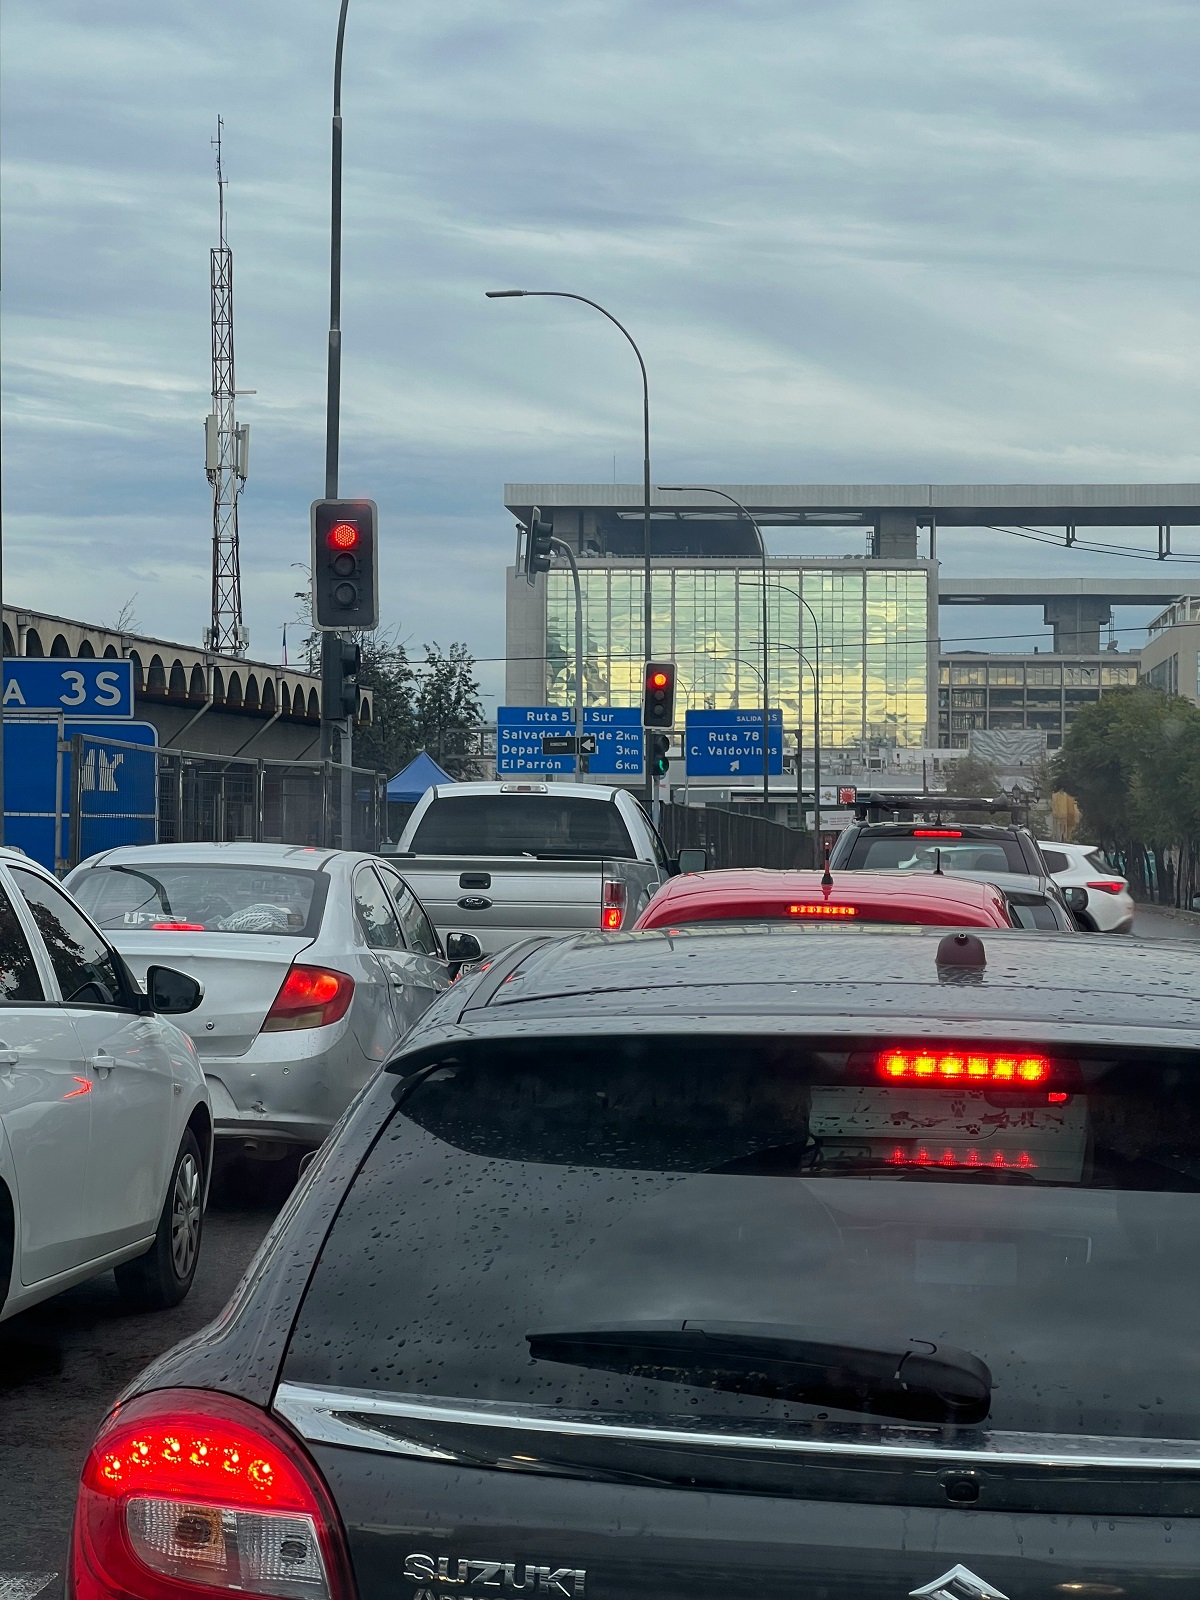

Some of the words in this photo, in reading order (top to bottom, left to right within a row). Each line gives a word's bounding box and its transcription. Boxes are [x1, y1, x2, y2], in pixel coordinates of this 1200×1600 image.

[59, 670, 121, 707] 3S
[527, 712, 557, 721] Ruta
[561, 712, 570, 721] 5
[592, 712, 614, 722] Sur
[709, 732, 738, 741] Ruta
[743, 732, 760, 741] 78
[691, 746, 702, 756] C.
[501, 759, 514, 769] El
[517, 759, 561, 769] Parrón
[403, 1553, 587, 1597] SUZUKI
